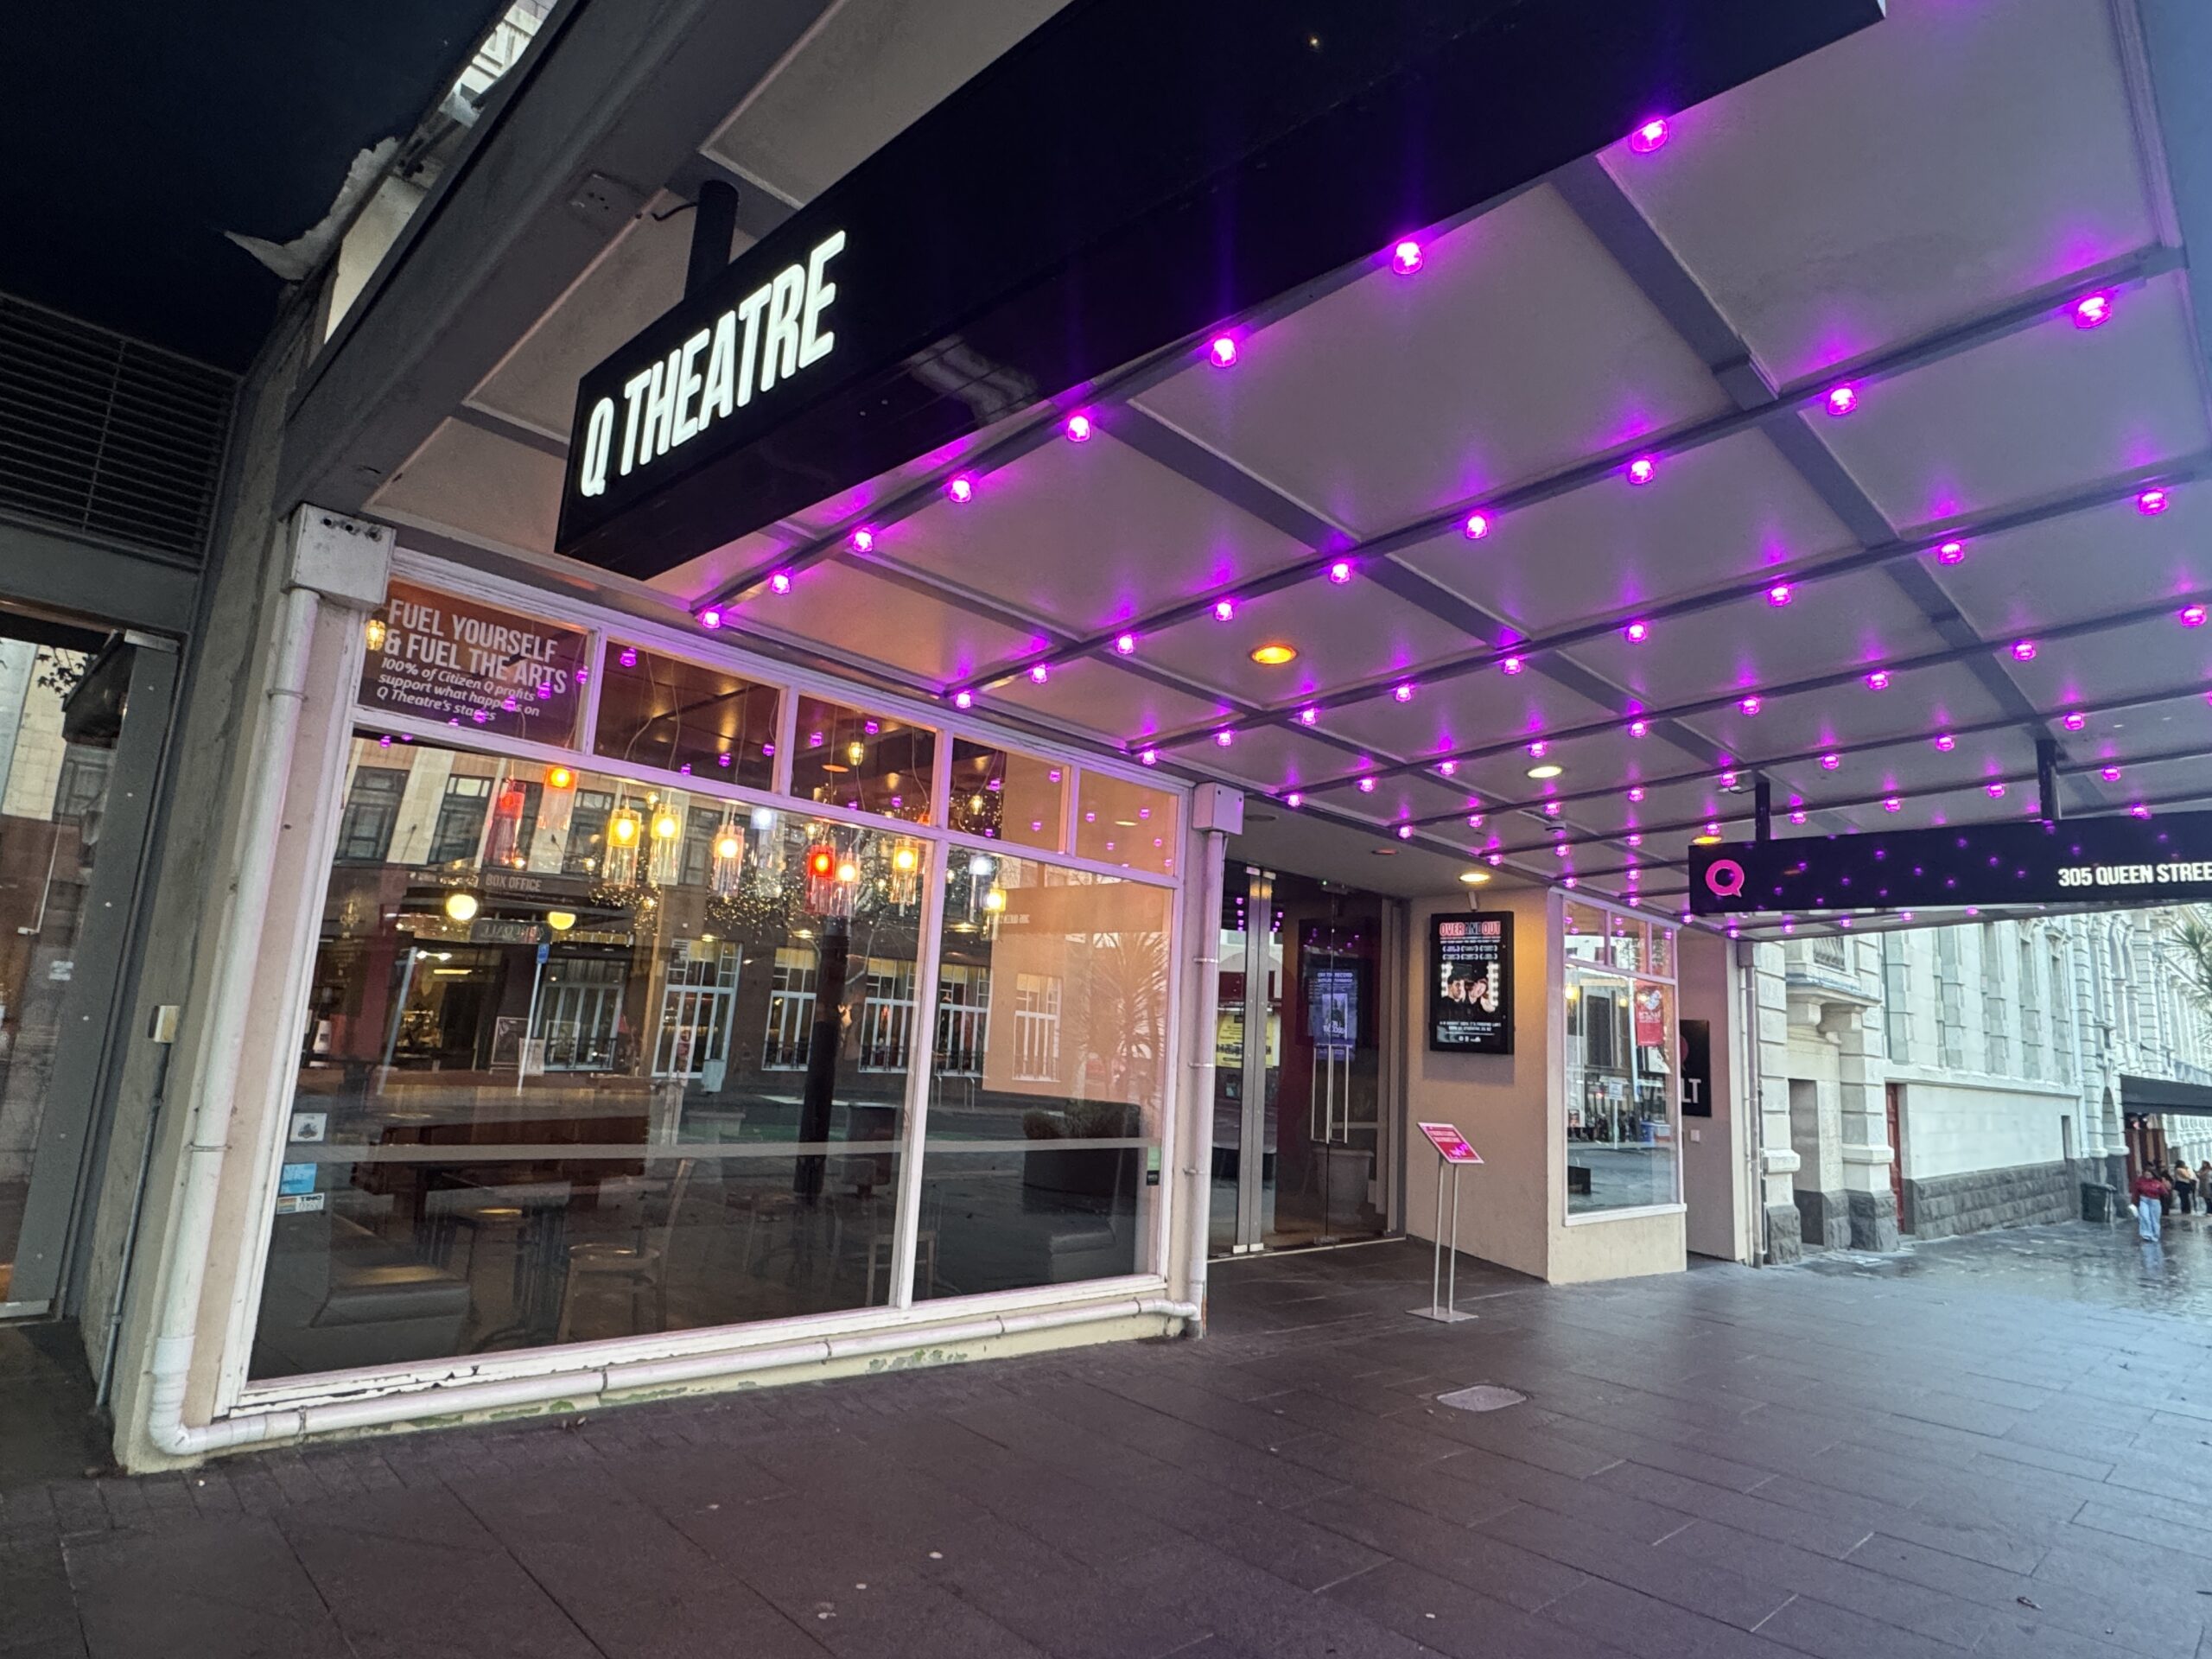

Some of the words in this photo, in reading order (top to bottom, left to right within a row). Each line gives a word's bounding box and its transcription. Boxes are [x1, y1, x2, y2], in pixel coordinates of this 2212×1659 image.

[581, 397, 614, 497] Q
[620, 230, 846, 476] THEATRE
[388, 598, 444, 637] FUEL
[452, 613, 558, 664] YOURSELF
[381, 657, 419, 676] 100%
[421, 668, 439, 682] of
[438, 671, 481, 690] Citizen
[484, 681, 494, 694] Q
[494, 685, 536, 702] profits
[384, 629, 402, 655] &
[405, 632, 461, 670] FUEL
[468, 648, 511, 681] THE
[513, 658, 567, 693] ARTS
[376, 686, 389, 700] Q
[391, 689, 452, 712] Theatre's
[453, 703, 497, 721] stas
[378, 674, 432, 693] support
[434, 685, 467, 701] what
[468, 690, 523, 712] happs
[524, 706, 540, 716] on
[486, 873, 506, 889] BOX
[508, 876, 543, 892] OFFICE
[2058, 867, 2093, 887] 305
[2095, 864, 2154, 886] QUEEN
[1440, 922, 1465, 937] OVER
[1482, 921, 1501, 935] OUT
